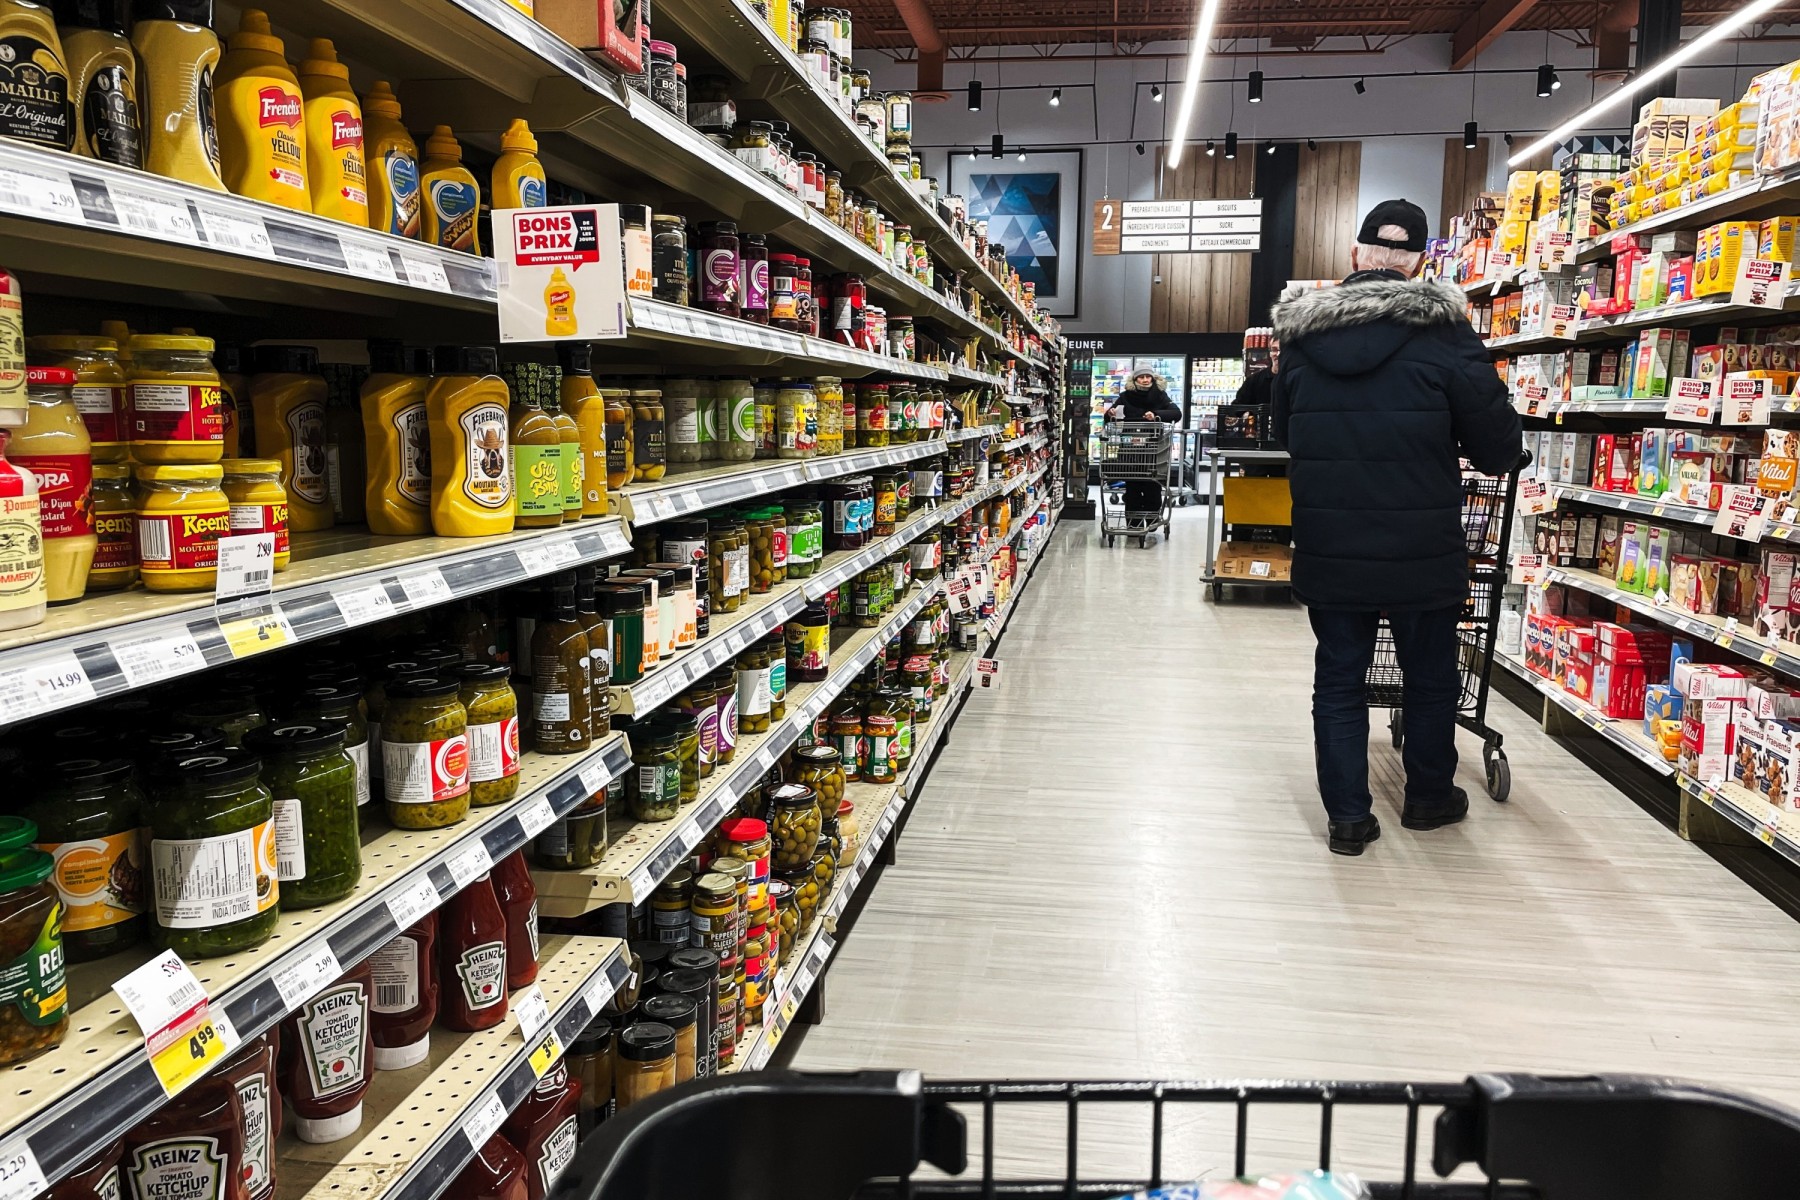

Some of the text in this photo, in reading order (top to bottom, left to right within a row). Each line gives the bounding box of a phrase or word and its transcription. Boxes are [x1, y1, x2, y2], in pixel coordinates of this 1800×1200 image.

[0, 81, 61, 104] MAILLE
[262, 98, 300, 118] French's
[276, 130, 296, 143] Classic
[271, 138, 301, 160] YELLOW
[49, 192, 75, 209] 2.99
[1217, 204, 1237, 212] BISCUITS
[171, 215, 192, 230] 6.79
[518, 217, 572, 233] BONS
[1102, 205, 1113, 230] 2
[1219, 221, 1234, 229] SUCRE
[1167, 222, 1186, 230] CUISSON
[251, 232, 268, 246] 6.79
[520, 233, 573, 250] PRIX
[1219, 238, 1251, 246] COMMERCIAUX
[1681, 386, 1701, 394] PRIX
[530, 461, 558, 483] Silly
[1681, 471, 1698, 480] VILLAGE
[1761, 461, 1792, 481] Vital
[473, 481, 499, 490] MOUTARDE
[529, 479, 560, 499] Billy
[1733, 500, 1754, 509] PRIX
[95, 517, 133, 534] een's
[182, 514, 230, 538] Keen's
[257, 542, 272, 558] 2.99
[93, 560, 128, 568] ORIGINAL
[1773, 554, 1794, 563] Vital
[374, 596, 388, 606] 4.99
[173, 643, 195, 658] 5.79
[48, 672, 82, 690] 14.99
[1707, 701, 1727, 709] Vital
[1682, 720, 1699, 742] Vital
[1740, 721, 1764, 740] Praeventia
[1766, 734, 1791, 754] Praeventia
[63, 856, 110, 868] compliments
[475, 851, 486, 863] 2.69
[419, 887, 433, 901] 2.49
[212, 905, 229, 919] INDIA
[232, 901, 250, 916] D'INDE
[711, 929, 737, 940] PEPPERS
[713, 939, 733, 948] SLICED
[315, 955, 333, 973] 2.99
[471, 950, 498, 965] HEINZ
[470, 963, 500, 978] KETCHUP
[316, 994, 354, 1015] HEINZ
[325, 1013, 349, 1026] TOMATO
[315, 1016, 359, 1040] KETCHUP
[320, 1028, 355, 1045] AUX TOMATES
[552, 1124, 572, 1149] HEINZ
[149, 1149, 202, 1169] HEINZ
[0, 1154, 27, 1181] 2.29
[159, 1170, 193, 1183] TOMATO
[146, 1175, 210, 1196] KETCHUP
[168, 1190, 203, 1200] TOMATES
